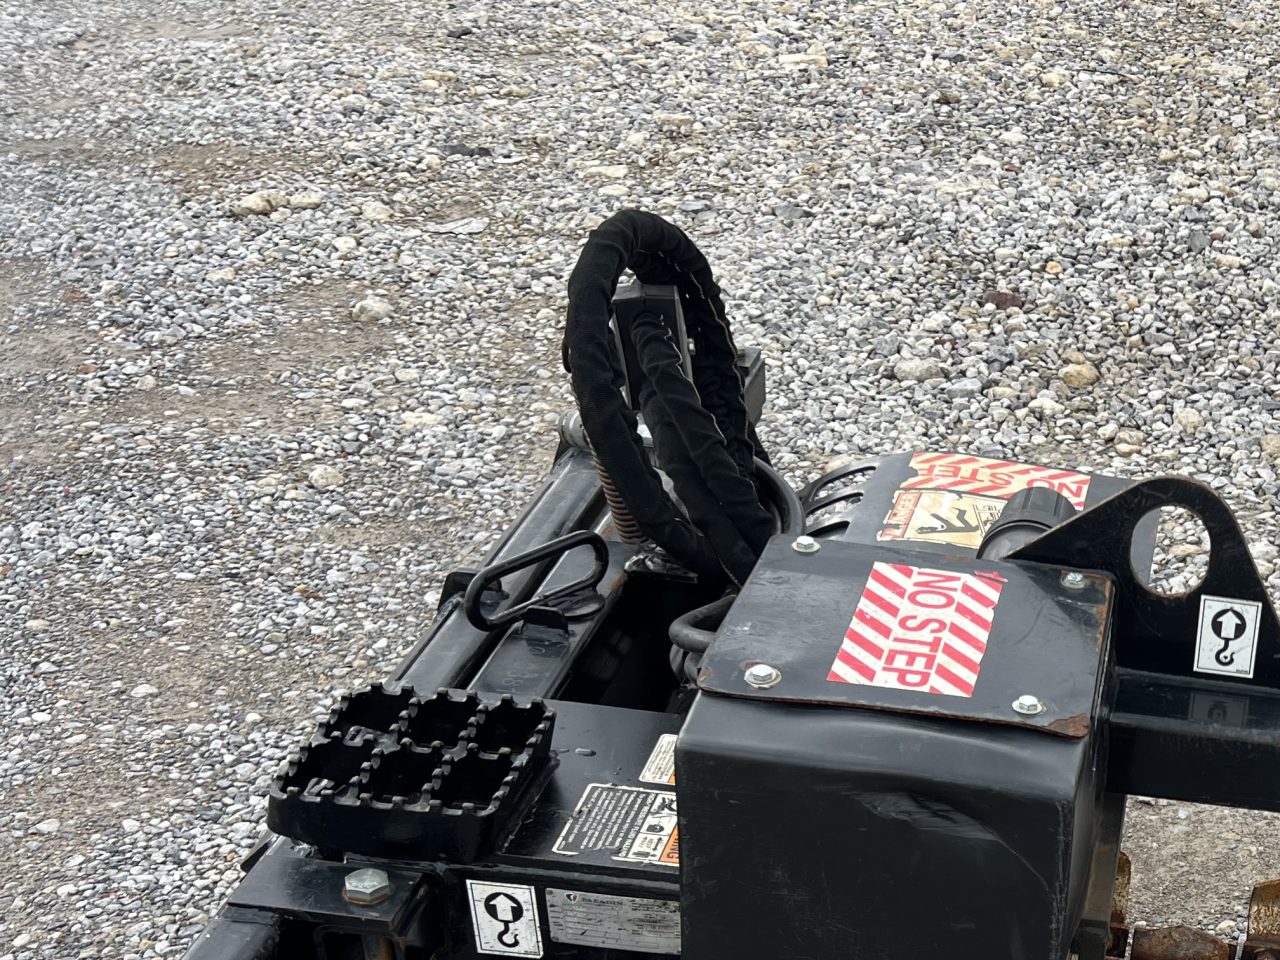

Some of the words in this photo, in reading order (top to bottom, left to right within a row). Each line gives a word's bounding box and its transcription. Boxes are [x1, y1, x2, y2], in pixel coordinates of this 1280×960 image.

[1026, 477, 1083, 499] NO
[907, 571, 961, 610] NO
[881, 615, 947, 687] STEP
